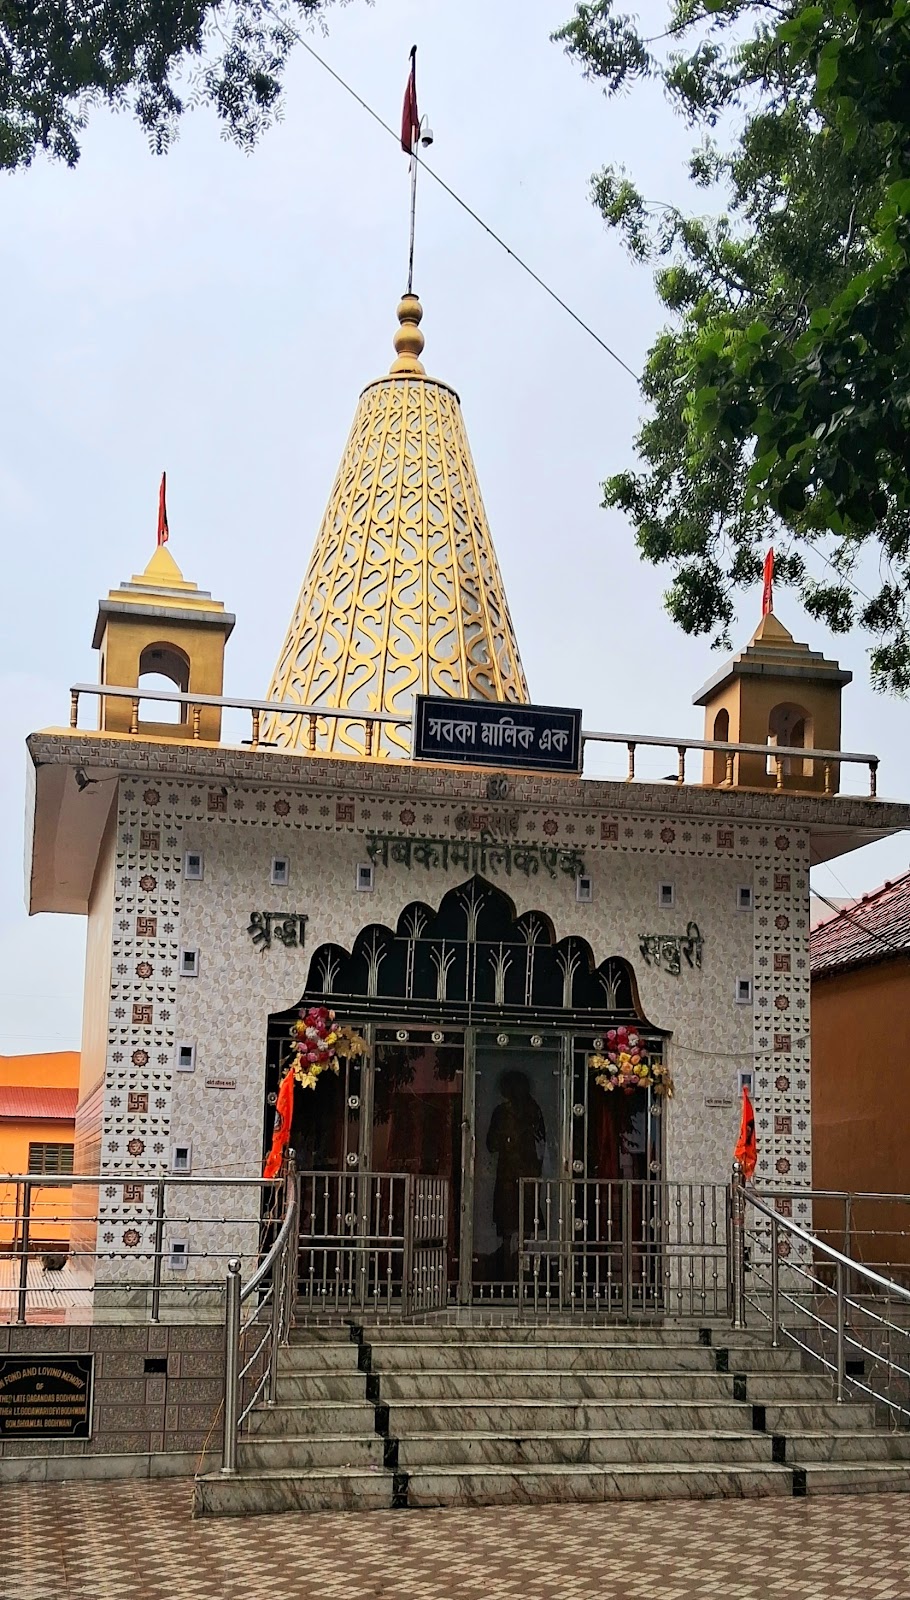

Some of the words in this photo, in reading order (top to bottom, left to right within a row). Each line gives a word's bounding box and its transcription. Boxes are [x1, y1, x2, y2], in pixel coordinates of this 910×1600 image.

[428, 718, 477, 745] সবকা
[481, 716, 535, 749] মালিক
[538, 728, 569, 752] এক
[246, 911, 309, 953] श्रद्धा
[638, 921, 704, 976] सबुरी
[4, 1370, 21, 1385] FOND
[22, 1367, 37, 1378] AND
[38, 1367, 62, 1378] LOVING
[60, 1371, 86, 1389] MEMORY
[35, 1382, 44, 1391] OF
[13, 1394, 26, 1403] LATE
